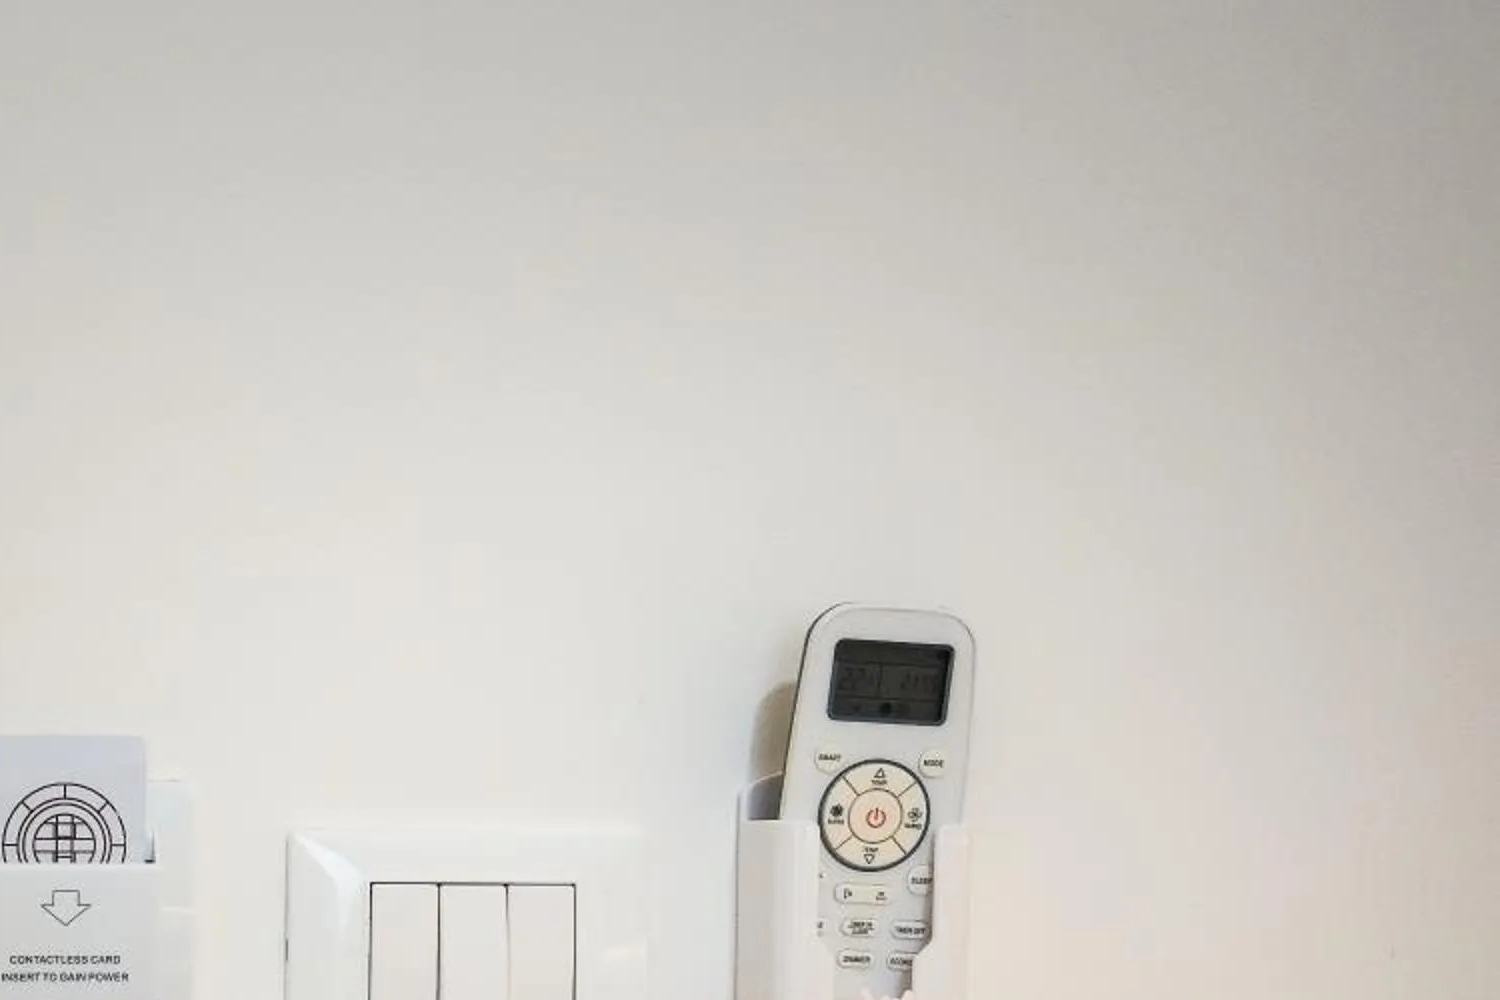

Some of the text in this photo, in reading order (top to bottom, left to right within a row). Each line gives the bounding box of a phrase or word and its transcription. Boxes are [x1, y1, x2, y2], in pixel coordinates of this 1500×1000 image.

[923, 759, 944, 767] MODE
[9, 955, 121, 965] CONTACTLESS CARD
[1, 971, 129, 982] INSERT TO GAIN POWER
